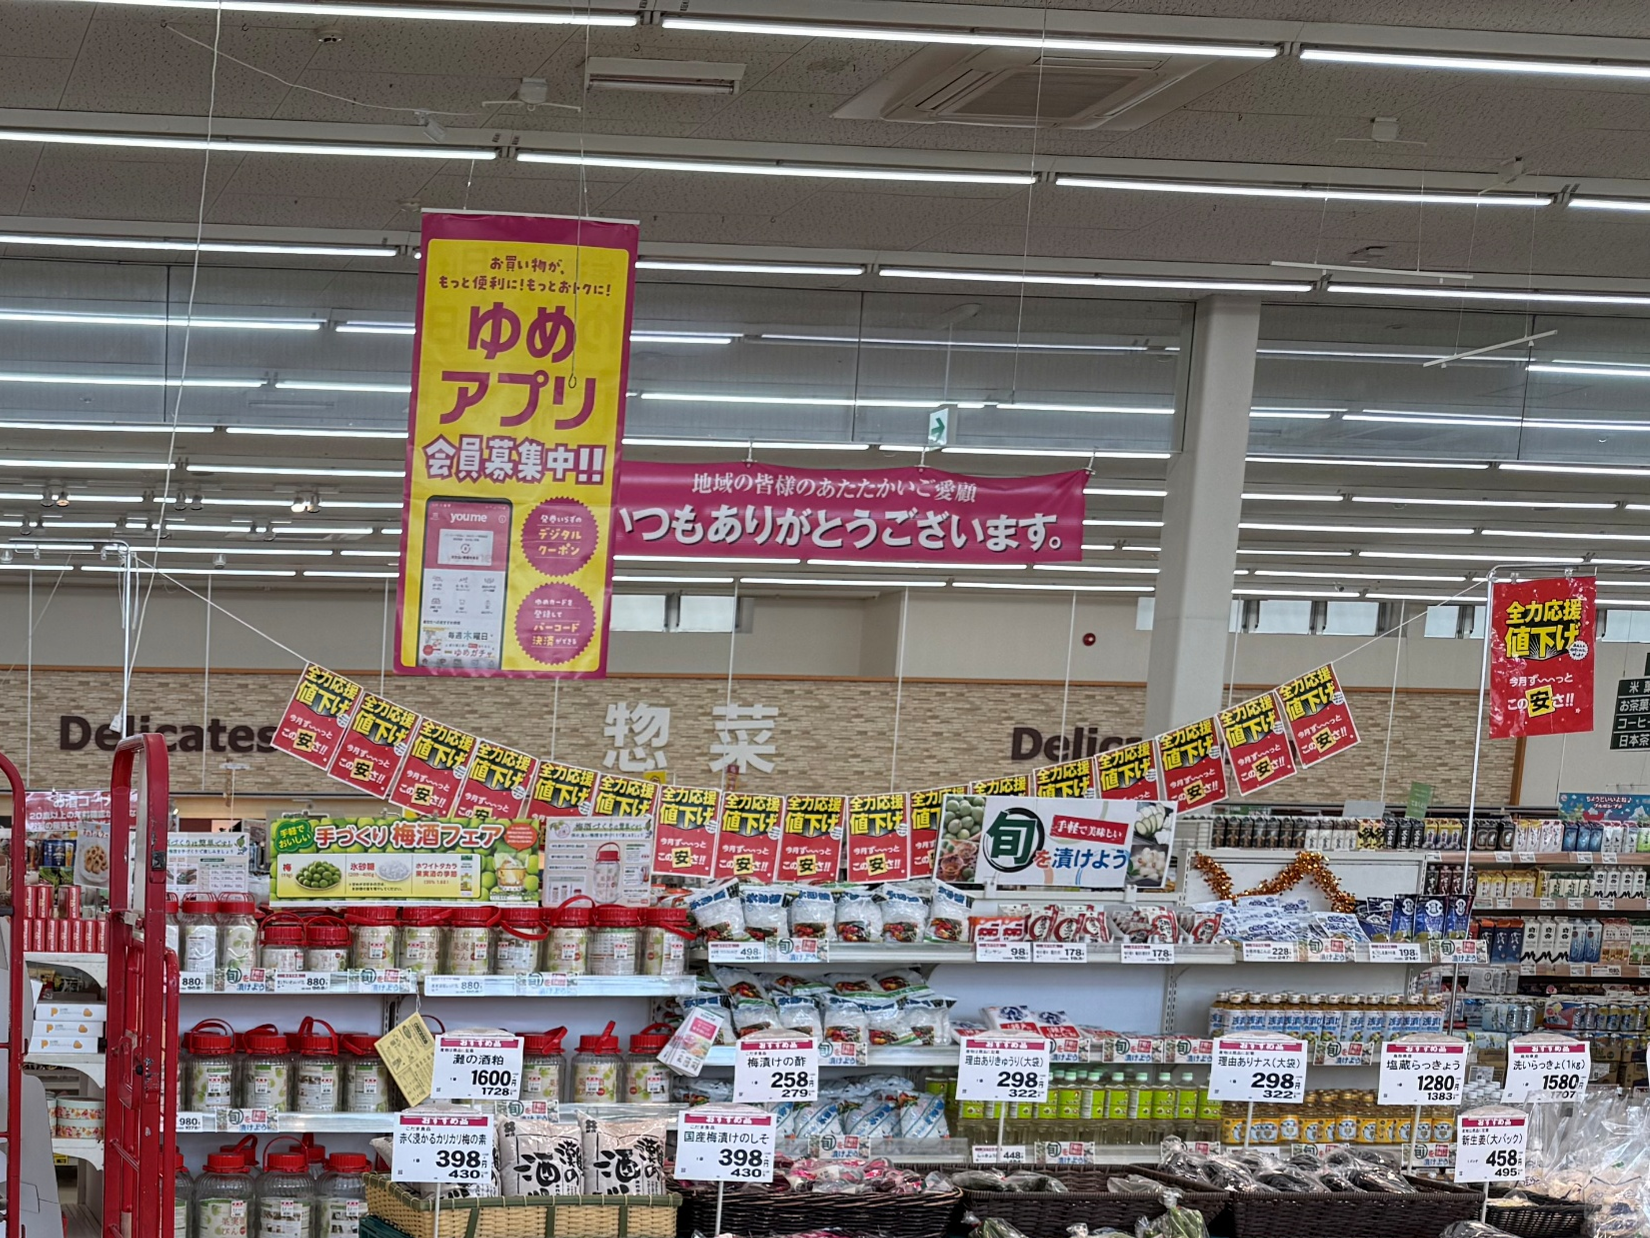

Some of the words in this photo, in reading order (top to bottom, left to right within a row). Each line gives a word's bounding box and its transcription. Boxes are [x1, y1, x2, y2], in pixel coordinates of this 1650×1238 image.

[490, 255, 565, 275] お買い物が、
[467, 301, 576, 363] ゆめ
[439, 369, 596, 430] アプリ
[422, 434, 607, 485] 会員募集中!!
[692, 472, 978, 503] 地域の皆様のあたたかいご愛顧
[538, 528, 582, 540] デジタル
[538, 543, 581, 556] クーポン
[1505, 598, 1582, 625] 全力応援
[534, 622, 580, 633] バーコード
[1505, 621, 1580, 659] 値下げ
[305, 665, 359, 701] 全力応援
[1279, 665, 1333, 700] 全力応援
[296, 680, 352, 716] 値下げ
[1285, 683, 1335, 721] 値下げ
[1507, 685, 1574, 718] この安さ!!
[361, 695, 416, 730] 全力応援
[1220, 694, 1274, 727] 全力応援
[353, 710, 409, 746] 値下げ
[420, 720, 474, 752] 全力応援
[1160, 720, 1212, 749] 全力応援
[1225, 710, 1276, 748] 値下げ
[281, 727, 329, 756] この安さ!!
[602, 701, 779, 774] 惣菜
[1011, 727, 1142, 762] Delic
[1302, 726, 1347, 755] この安さ!!
[1619, 734, 1650, 748] 日本茶
[478, 743, 532, 772] 全力応援
[1162, 736, 1214, 771] 値下げ
[1241, 756, 1285, 781] この安さ!!
[279, 825, 305, 838] 手軽で
[315, 821, 504, 849] 手づくり梅酒フェア
[1056, 819, 1122, 840] 手軽で美味しい
[279, 834, 312, 848] おいしい
[350, 862, 375, 872] 氷砂糖
[1010, 947, 1026, 956] 98
[1064, 949, 1082, 957] 178
[1272, 947, 1289, 956] 228
[1399, 948, 1416, 957] 198
[182, 977, 201, 986] 880
[306, 977, 326, 986] 880
[747, 1056, 807, 1068] 梅漬けの酢
[1386, 1058, 1461, 1071] 塩蔵らっきょう
[471, 1069, 511, 1087] 1600
[770, 1071, 809, 1088] 258
[997, 1071, 1038, 1088] 298
[1250, 1072, 1294, 1089] 298
[1417, 1075, 1455, 1091] 1280
[1542, 1074, 1580, 1090] 1580
[481, 1087, 510, 1096] 1728
[781, 1089, 808, 1098] 279
[1008, 1089, 1037, 1098] 322
[1262, 1090, 1293, 1099] 322
[1427, 1092, 1453, 1101] 1383
[1550, 1091, 1576, 1099] 1707
[179, 1117, 198, 1126] 980
[683, 1130, 770, 1145] 国産梅漬けのしそ
[435, 1150, 481, 1168] 398
[718, 1148, 763, 1167] 398
[1485, 1149, 1517, 1167] 458
[448, 1169, 480, 1179] 430
[730, 1168, 762, 1178] 430
[1494, 1168, 1518, 1177] 495
